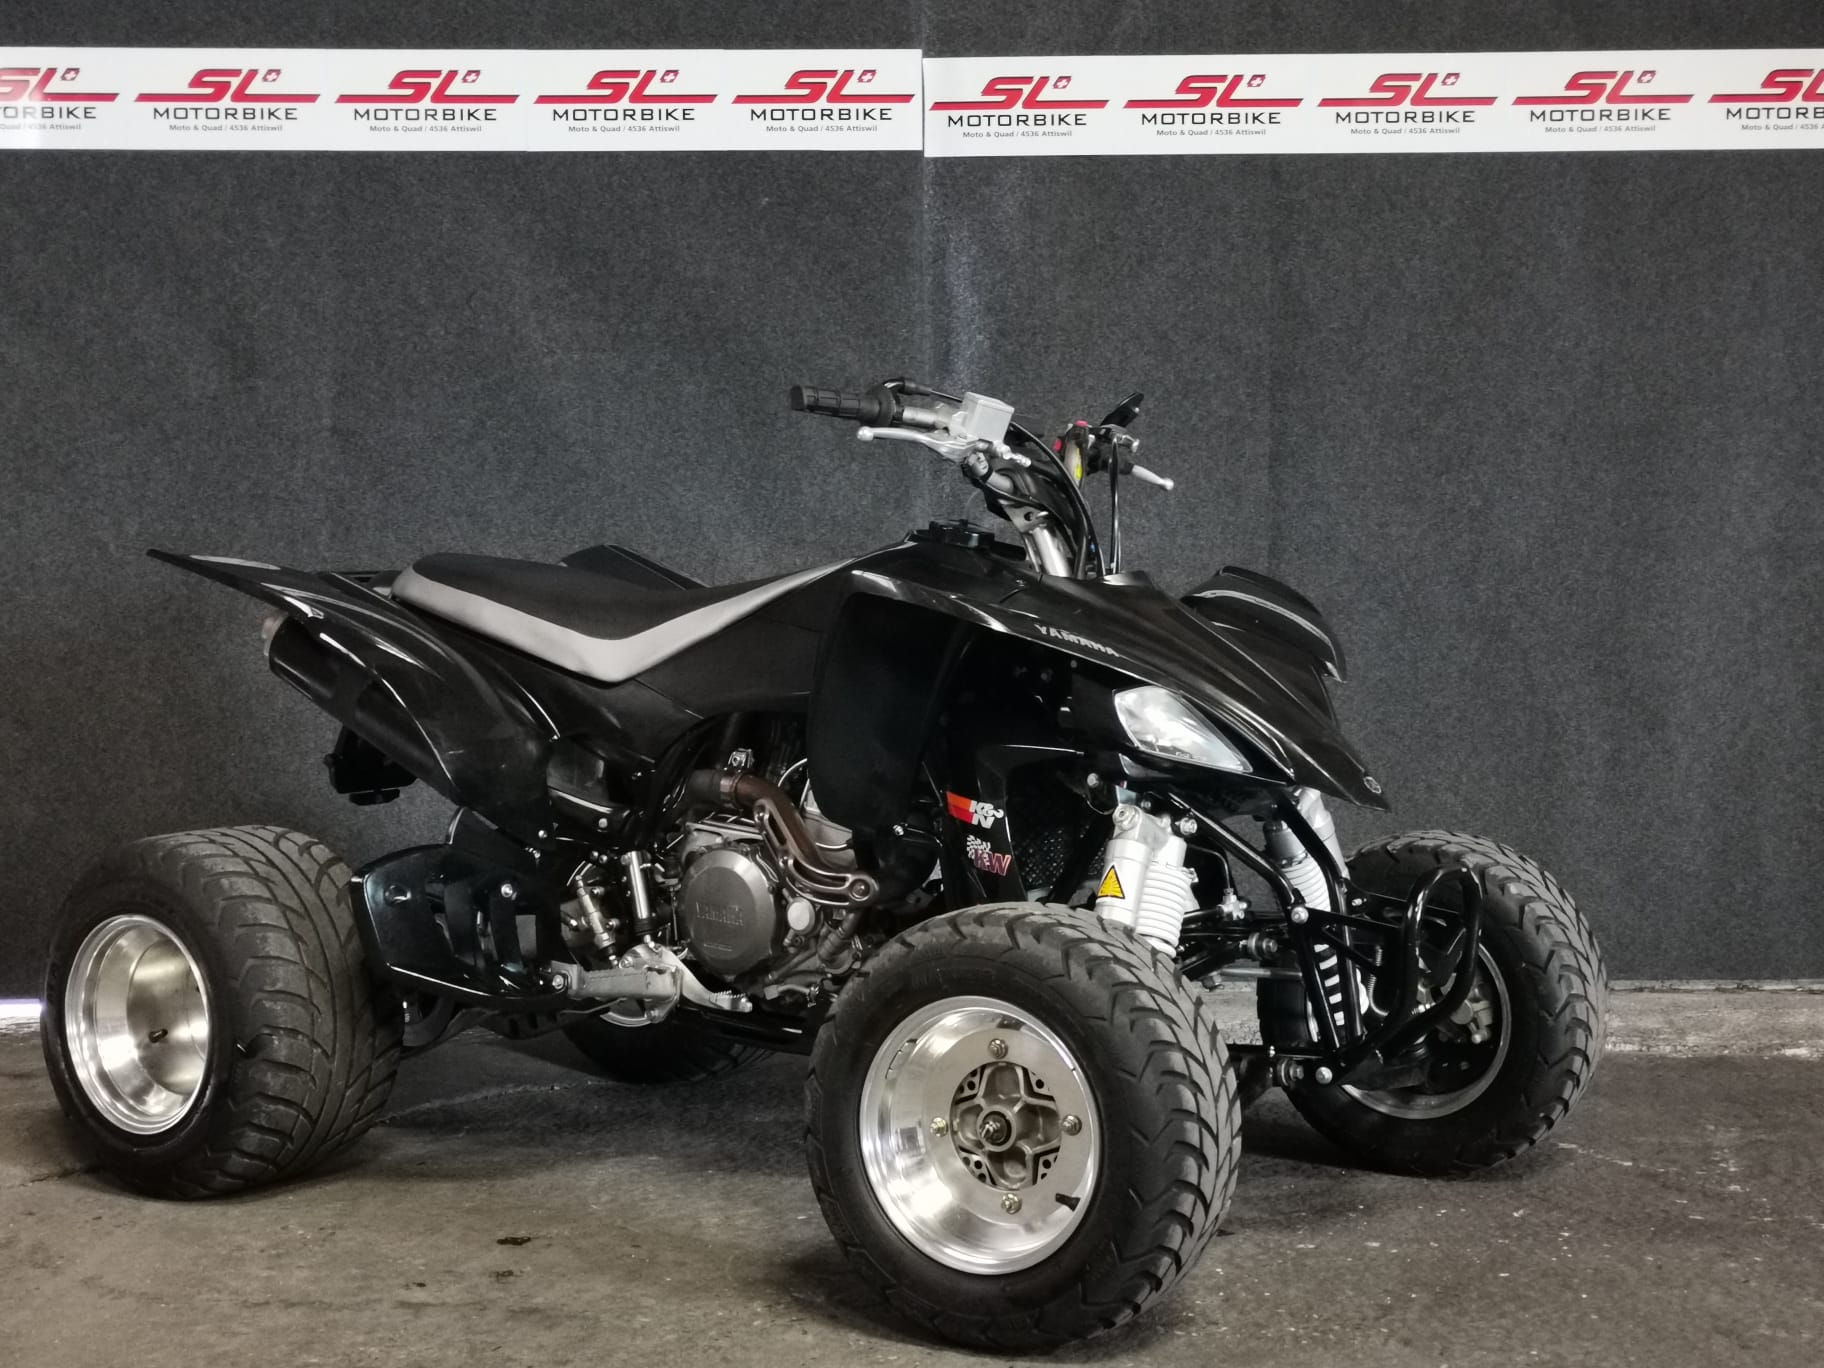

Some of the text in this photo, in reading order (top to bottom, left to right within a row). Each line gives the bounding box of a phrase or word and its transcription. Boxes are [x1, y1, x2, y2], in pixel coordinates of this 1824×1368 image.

[153, 107, 297, 120] MOTORBIKE
[354, 108, 496, 121] MOTORBIKE
[552, 108, 695, 121] MOTORBIKE
[750, 108, 892, 121] MOTORBIKE
[947, 113, 1087, 127] MOTORBIKE
[1141, 112, 1281, 125] MOTORBIKE
[1335, 110, 1475, 124] MOTORBIKE
[1529, 108, 1671, 122] MOTORBIKE
[1033, 623, 1119, 657] YAMAHA
